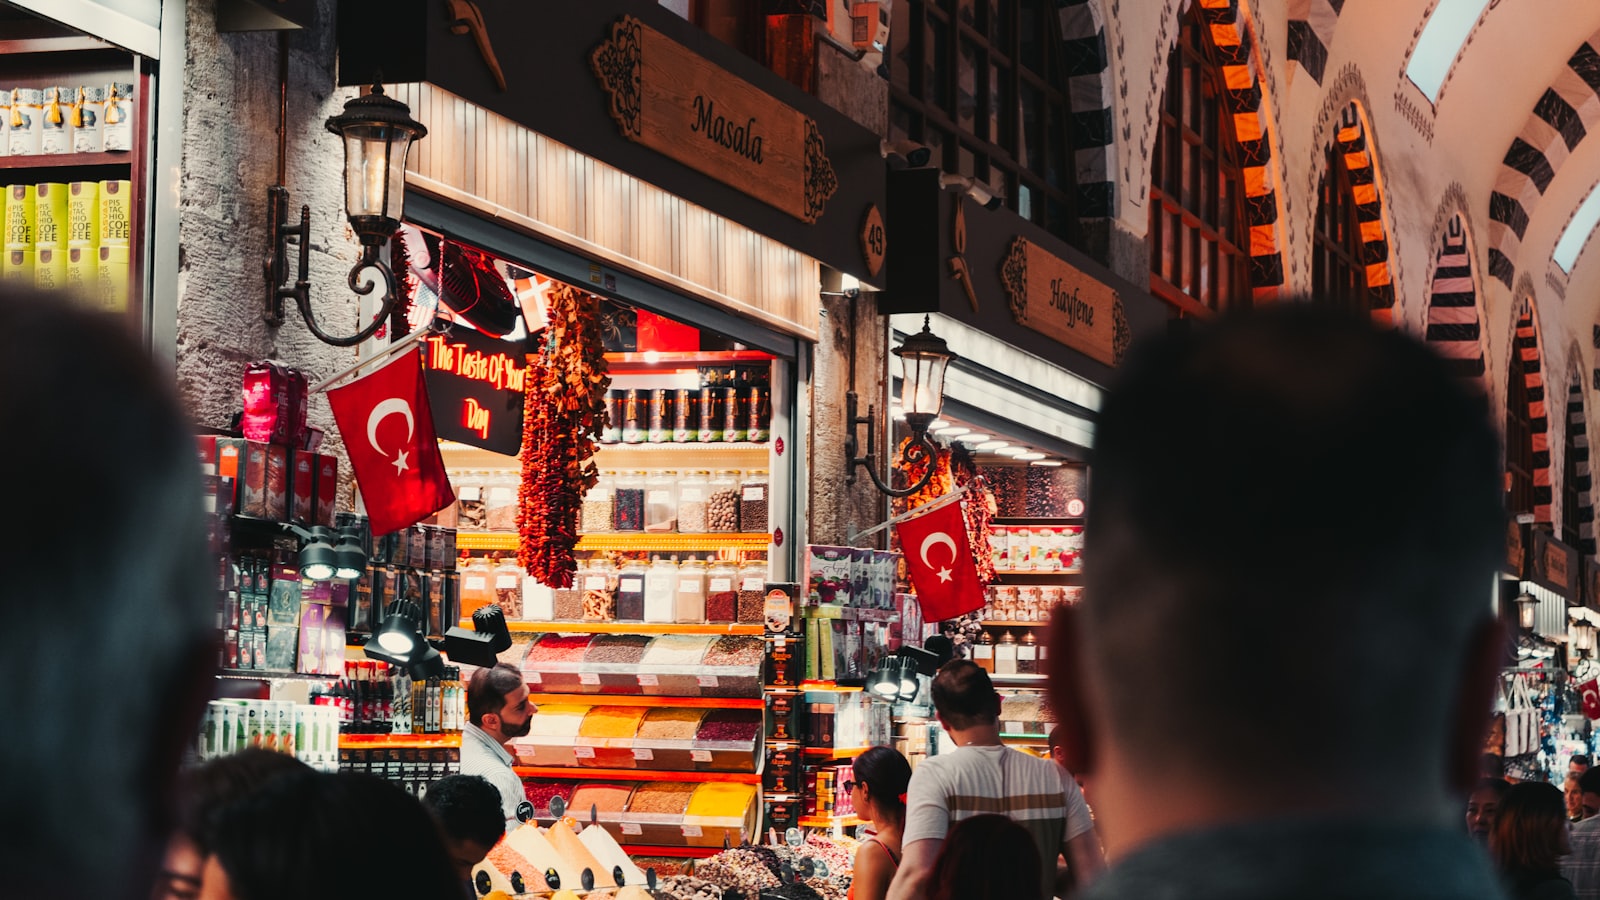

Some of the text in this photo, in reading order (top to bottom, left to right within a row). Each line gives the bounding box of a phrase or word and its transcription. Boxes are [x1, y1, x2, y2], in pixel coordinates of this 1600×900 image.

[690, 95, 764, 165] Masala
[12, 226, 31, 234] COF
[39, 224, 57, 233] COF
[72, 222, 92, 231] COF
[108, 220, 129, 230] COF
[12, 234, 31, 244] FEE
[40, 234, 57, 242] FEE
[72, 232, 92, 240] FEE
[108, 230, 129, 238] FEE
[868, 224, 883, 256] 49
[1049, 277, 1094, 328] Hayfene
[427, 335, 526, 392] The Taste Of Your
[464, 397, 490, 440] Day
